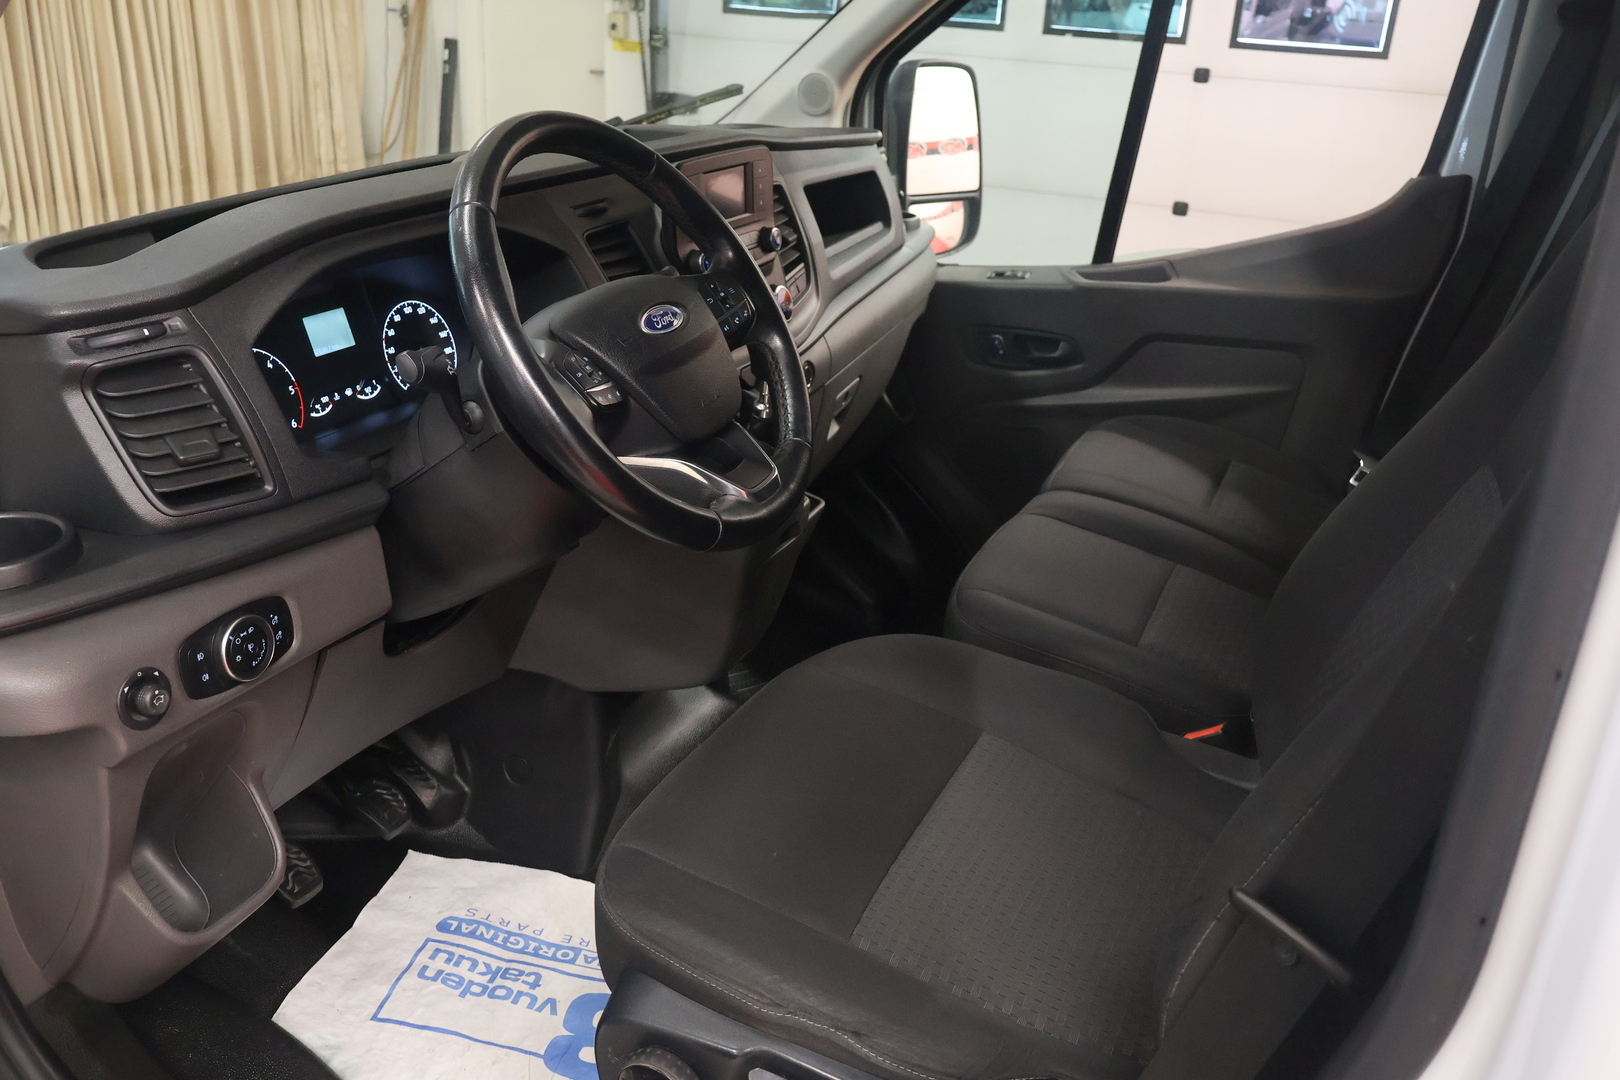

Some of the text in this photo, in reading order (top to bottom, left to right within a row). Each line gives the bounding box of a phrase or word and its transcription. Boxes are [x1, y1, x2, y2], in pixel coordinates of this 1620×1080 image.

[650, 310, 677, 329] Ford
[267, 360, 273, 369] 4
[288, 385, 295, 395] 5
[291, 418, 298, 429] 6
[464, 907, 545, 936] PARTS
[446, 919, 575, 961] ORIGINAL
[428, 947, 543, 991] takuu
[417, 964, 558, 1016] vuoden
